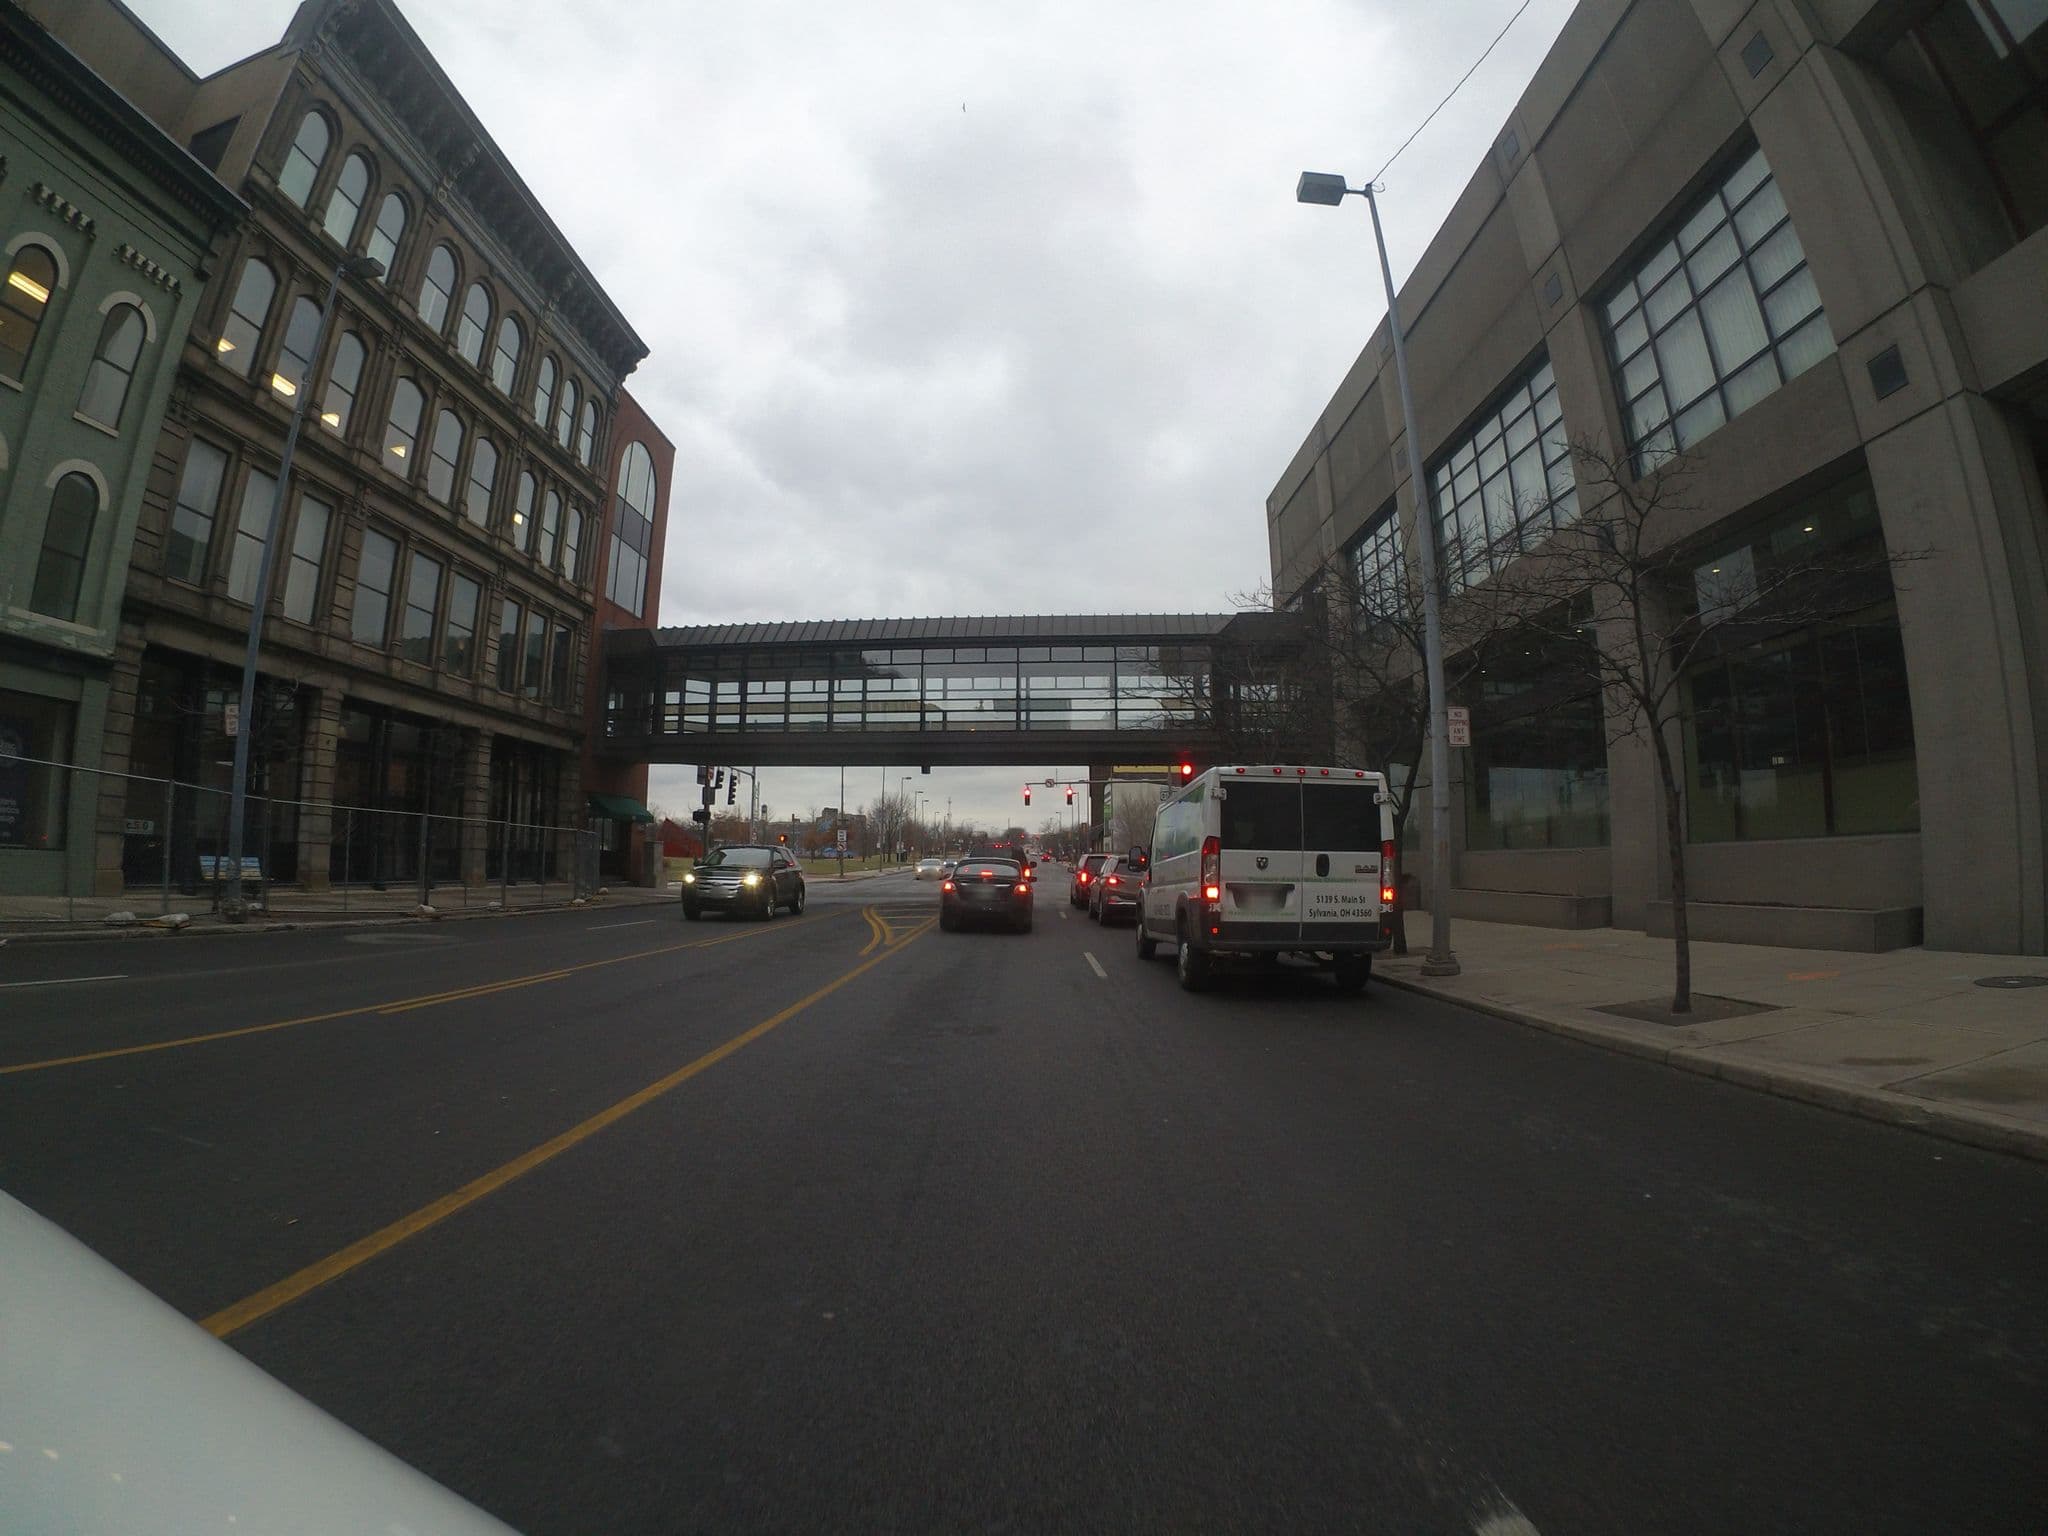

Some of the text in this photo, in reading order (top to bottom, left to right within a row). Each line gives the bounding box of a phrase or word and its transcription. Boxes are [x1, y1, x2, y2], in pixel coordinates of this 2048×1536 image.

[1341, 895, 1358, 904] Main
[1358, 895, 1366, 904] St
[1309, 909, 1372, 919] Sylvania, OH 43560
